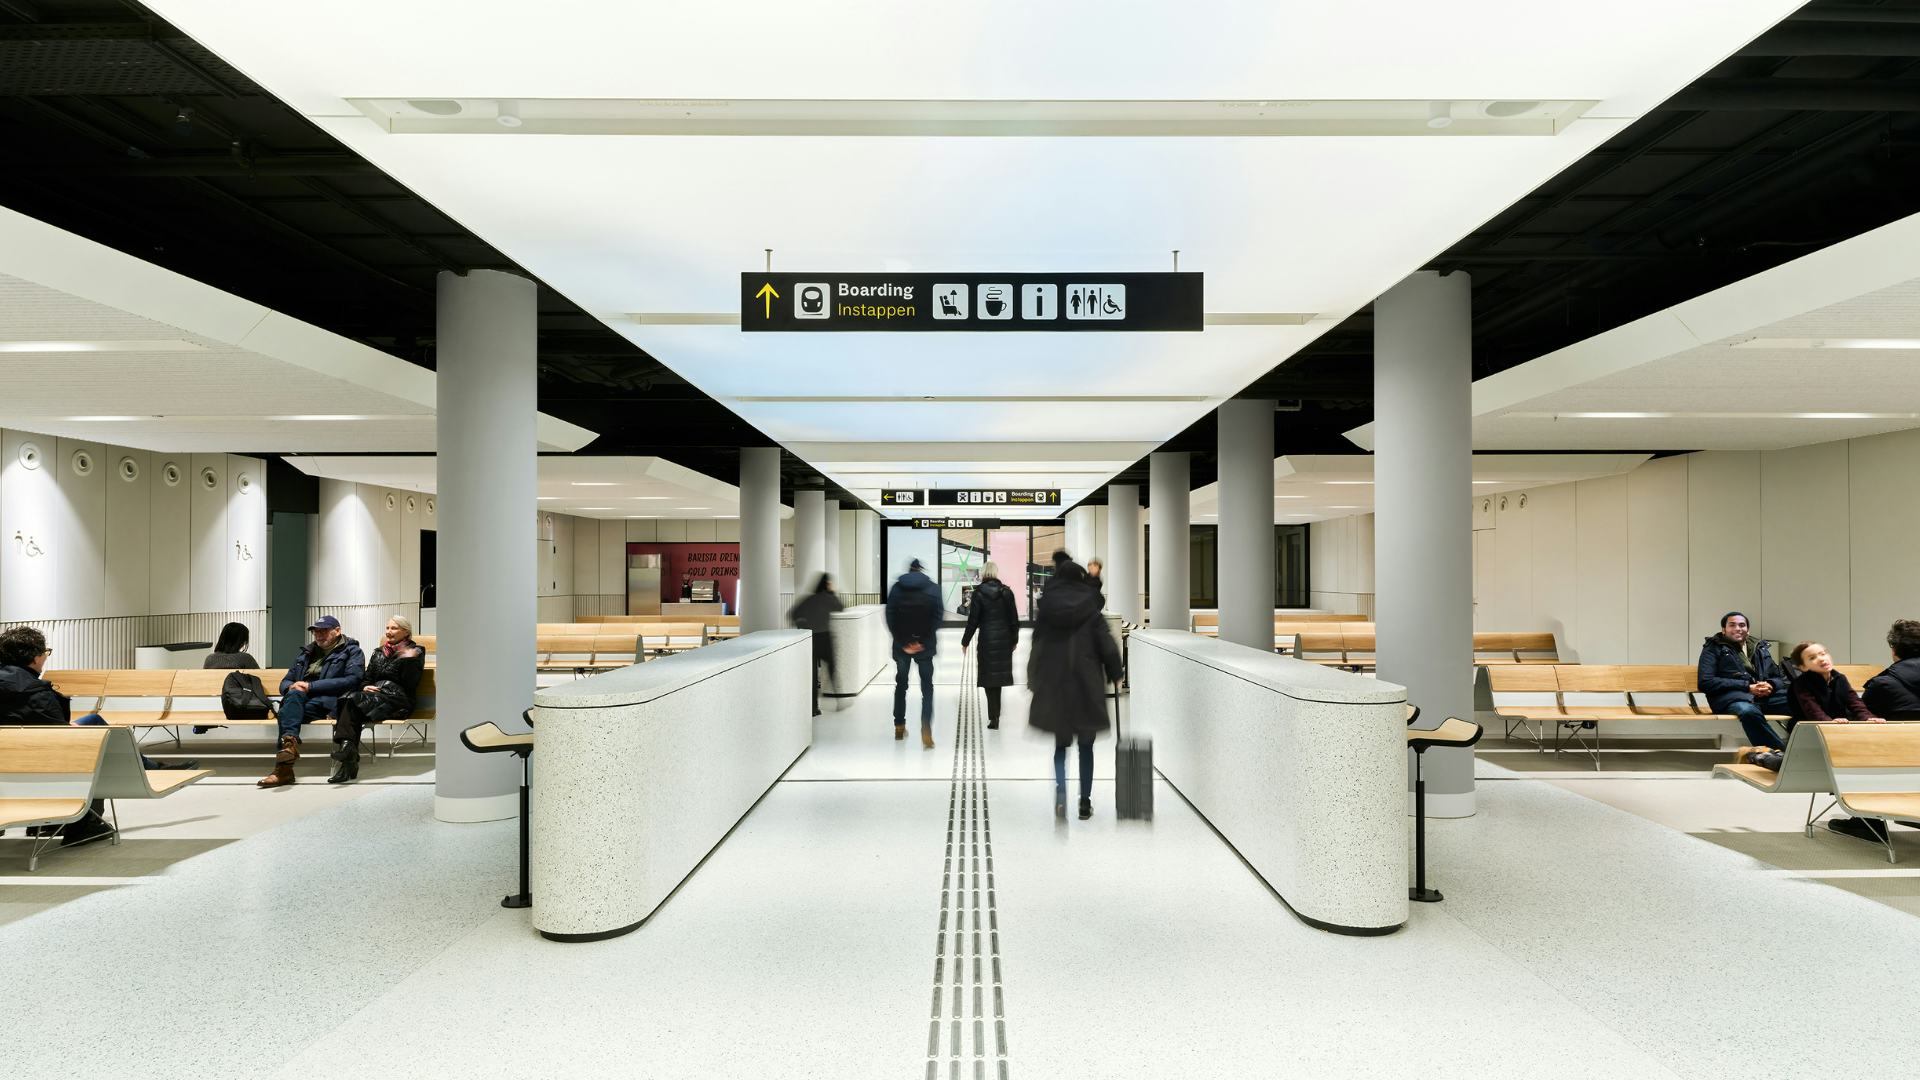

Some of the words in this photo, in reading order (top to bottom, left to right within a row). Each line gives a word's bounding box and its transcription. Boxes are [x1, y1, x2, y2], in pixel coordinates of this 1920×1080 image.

[838, 282, 914, 300] Boarding
[838, 303, 916, 320] Instappen
[687, 552, 717, 562] BARISTA
[711, 566, 738, 577] DRINKS
